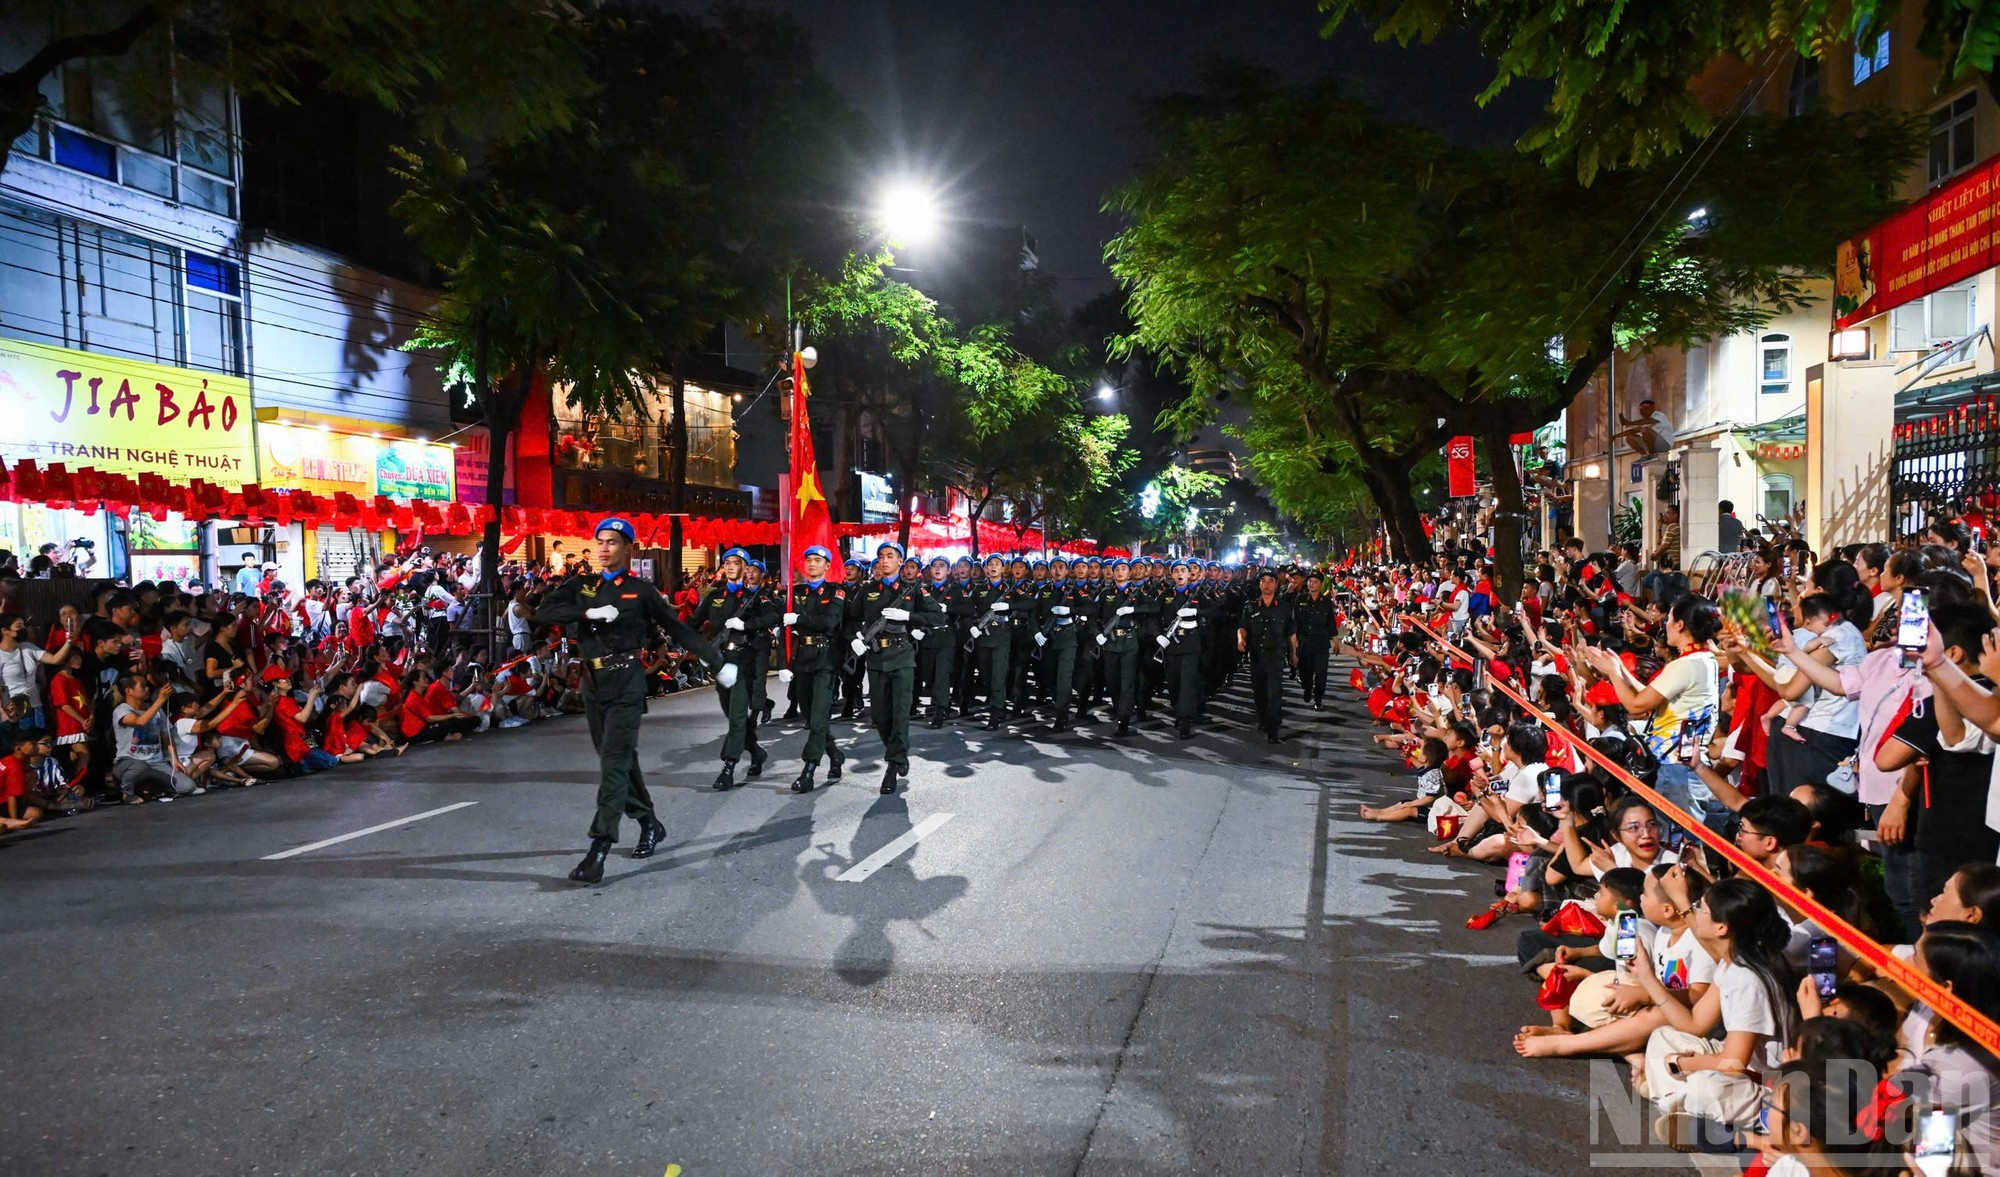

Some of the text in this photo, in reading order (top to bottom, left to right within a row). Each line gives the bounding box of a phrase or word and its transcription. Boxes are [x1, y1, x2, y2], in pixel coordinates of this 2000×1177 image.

[50, 369, 238, 432] JIA BẢO
[48, 441, 119, 460] TRANH
[127, 448, 179, 468] NGHỆ
[184, 454, 241, 472] THUẬT
